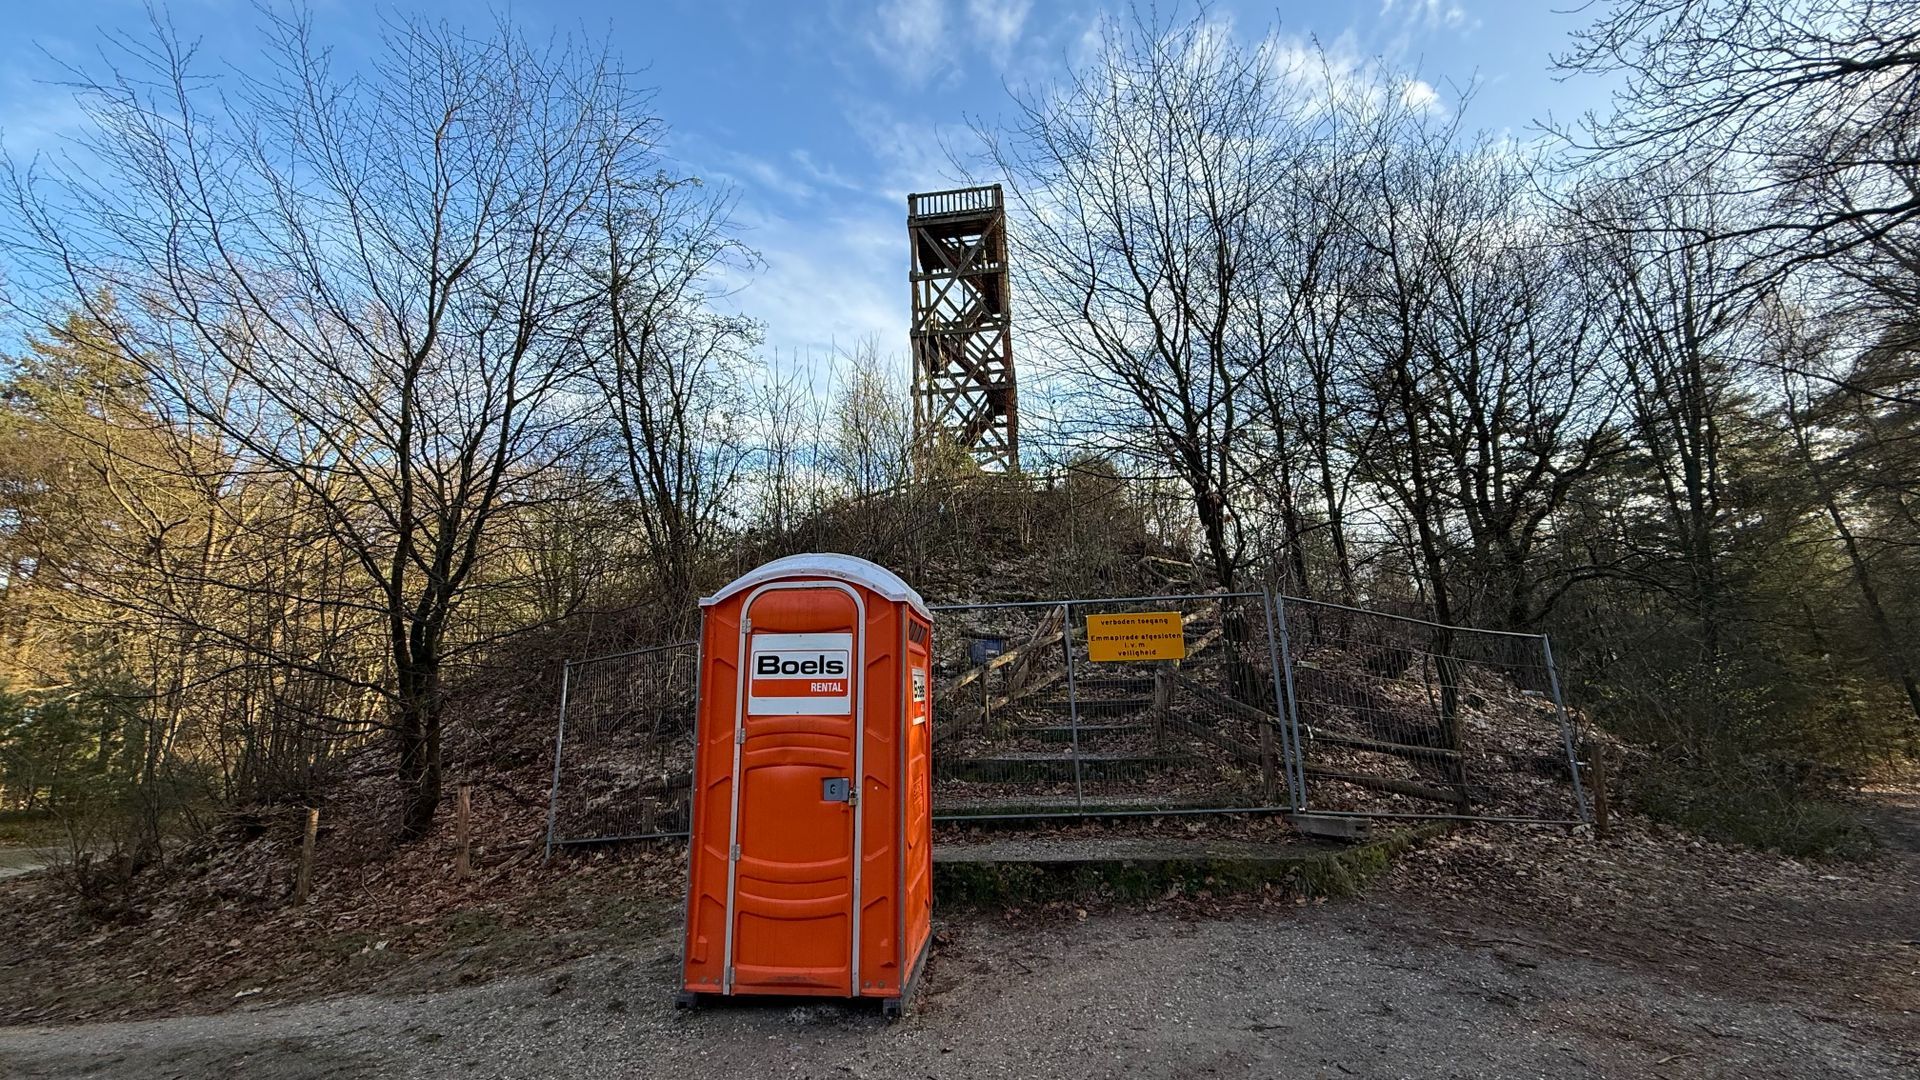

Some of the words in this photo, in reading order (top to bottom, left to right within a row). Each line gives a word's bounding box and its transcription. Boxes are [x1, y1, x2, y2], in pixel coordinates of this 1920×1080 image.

[1118, 649, 1156, 657] veiligheid
[757, 655, 843, 674] Boels
[811, 682, 843, 692] RENTAL
